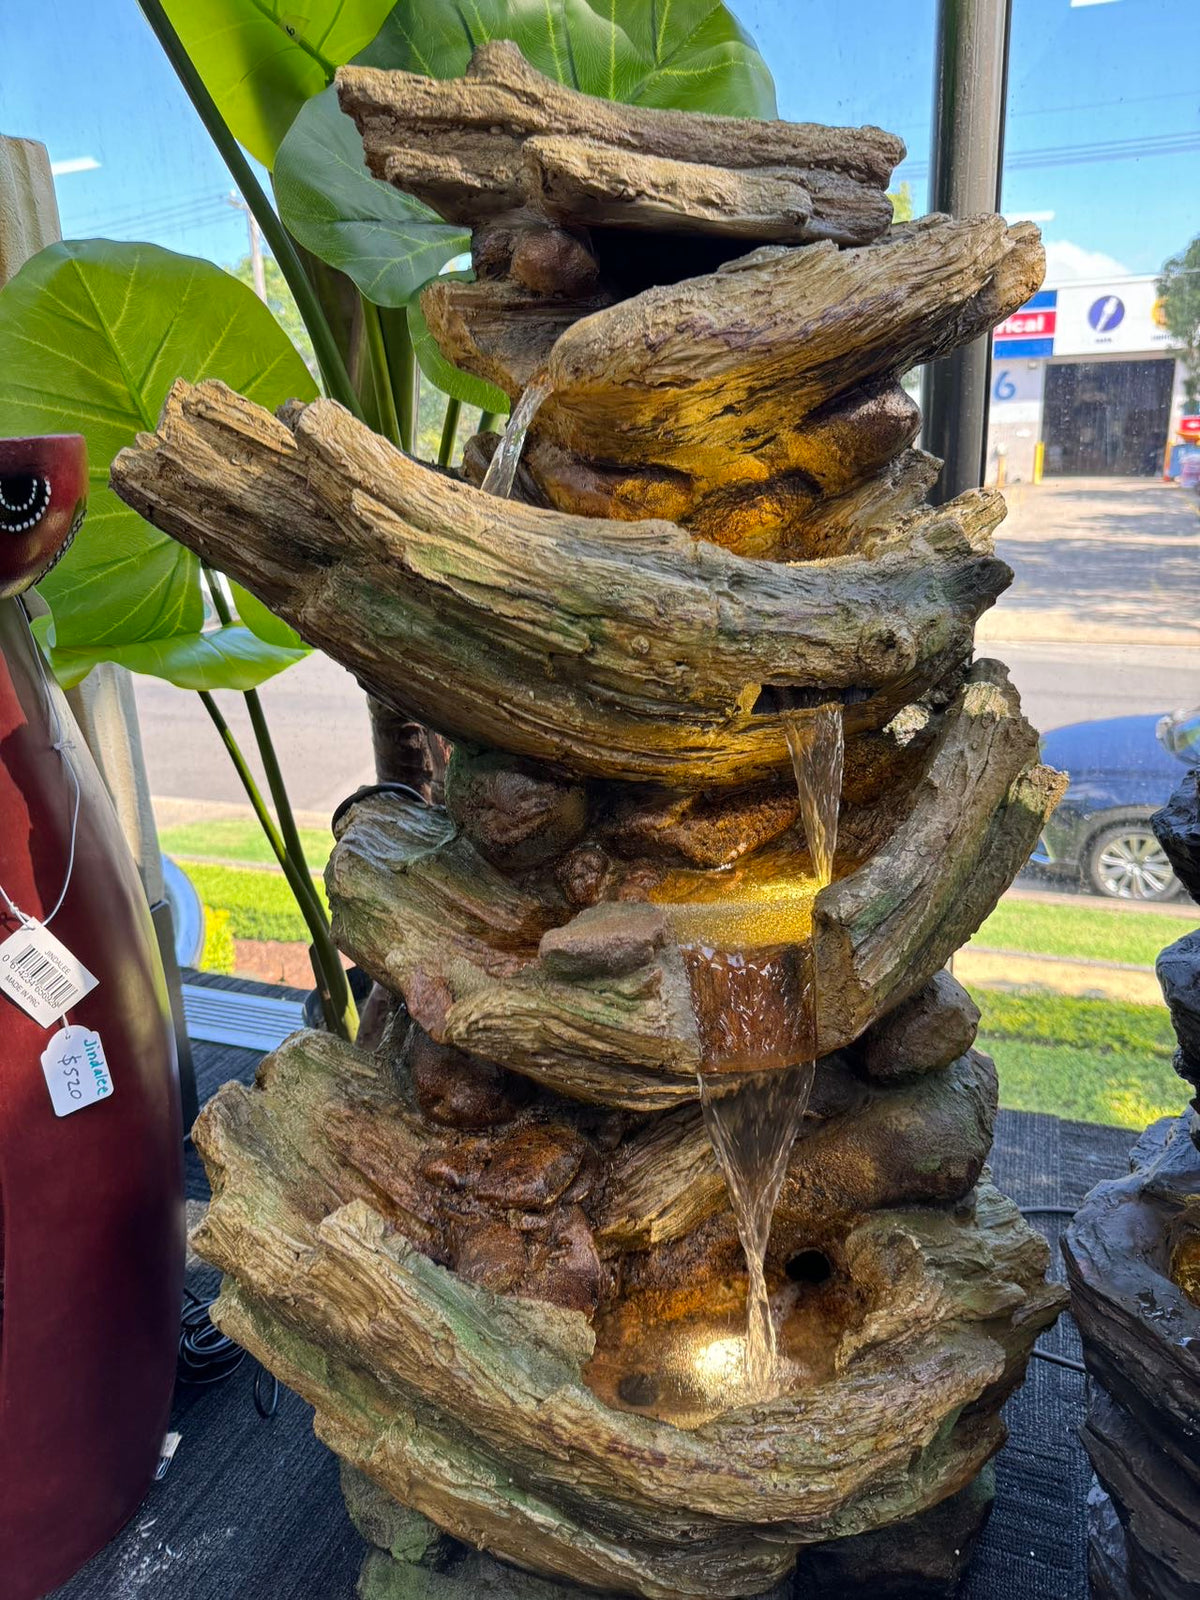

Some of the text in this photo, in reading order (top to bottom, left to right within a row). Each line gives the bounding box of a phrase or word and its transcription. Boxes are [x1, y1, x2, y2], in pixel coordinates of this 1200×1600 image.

[994, 371, 1016, 400] 6
[2, 954, 10, 963] 0
[45, 950, 71, 976] JINDALEE
[5, 974, 40, 1008] MADE IN PRC
[57, 1054, 82, 1100] $520
[84, 1039, 109, 1096] Jindalee
